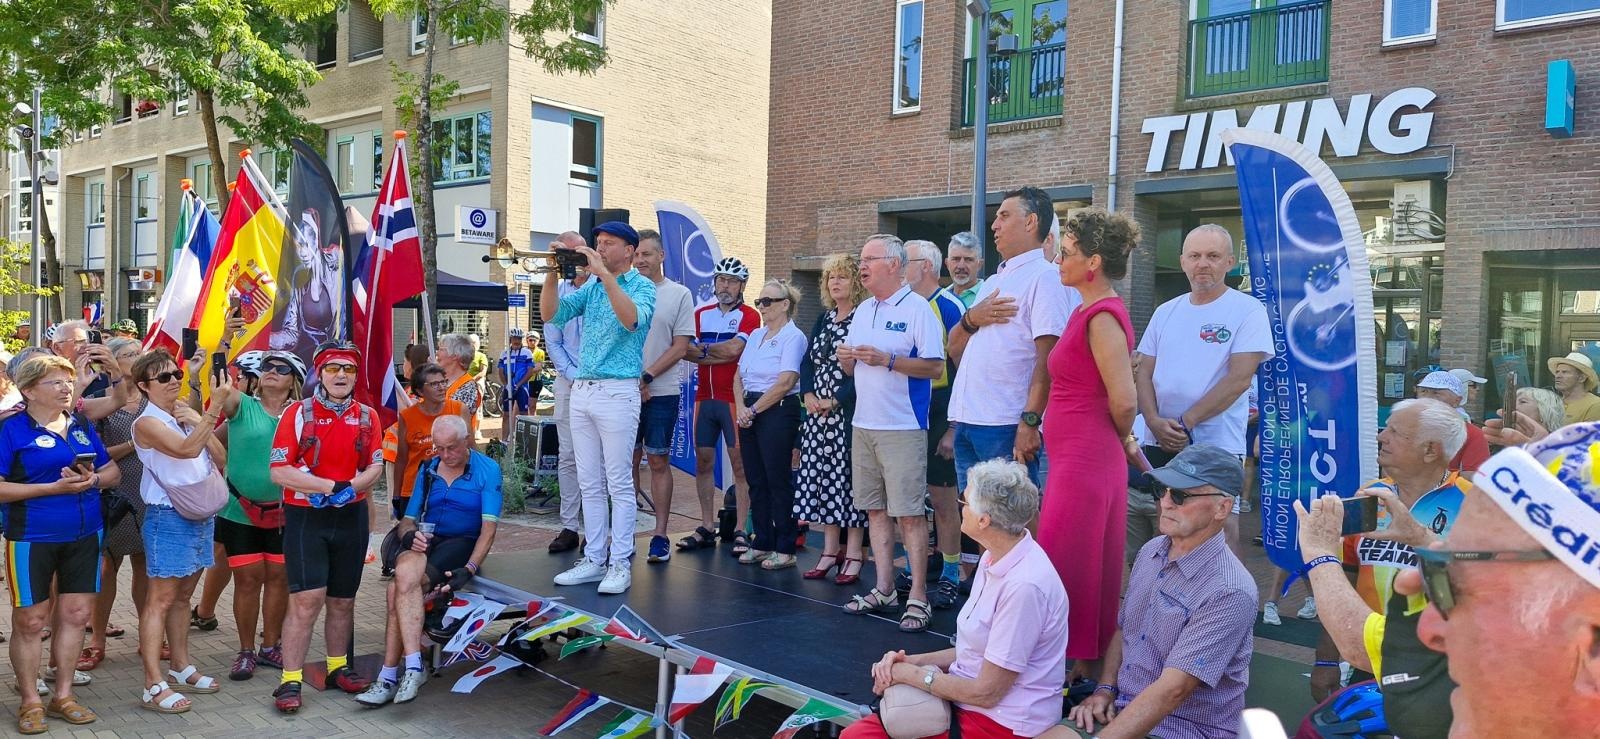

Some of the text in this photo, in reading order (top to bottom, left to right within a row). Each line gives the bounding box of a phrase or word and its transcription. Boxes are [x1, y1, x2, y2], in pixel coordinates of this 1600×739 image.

[1141, 87, 1437, 172] TIMING
[461, 228, 495, 238] BETAWARE
[1491, 466, 1600, 575] Crédi
[1359, 549, 1419, 567] TEAM
[1382, 672, 1420, 686] GEL
